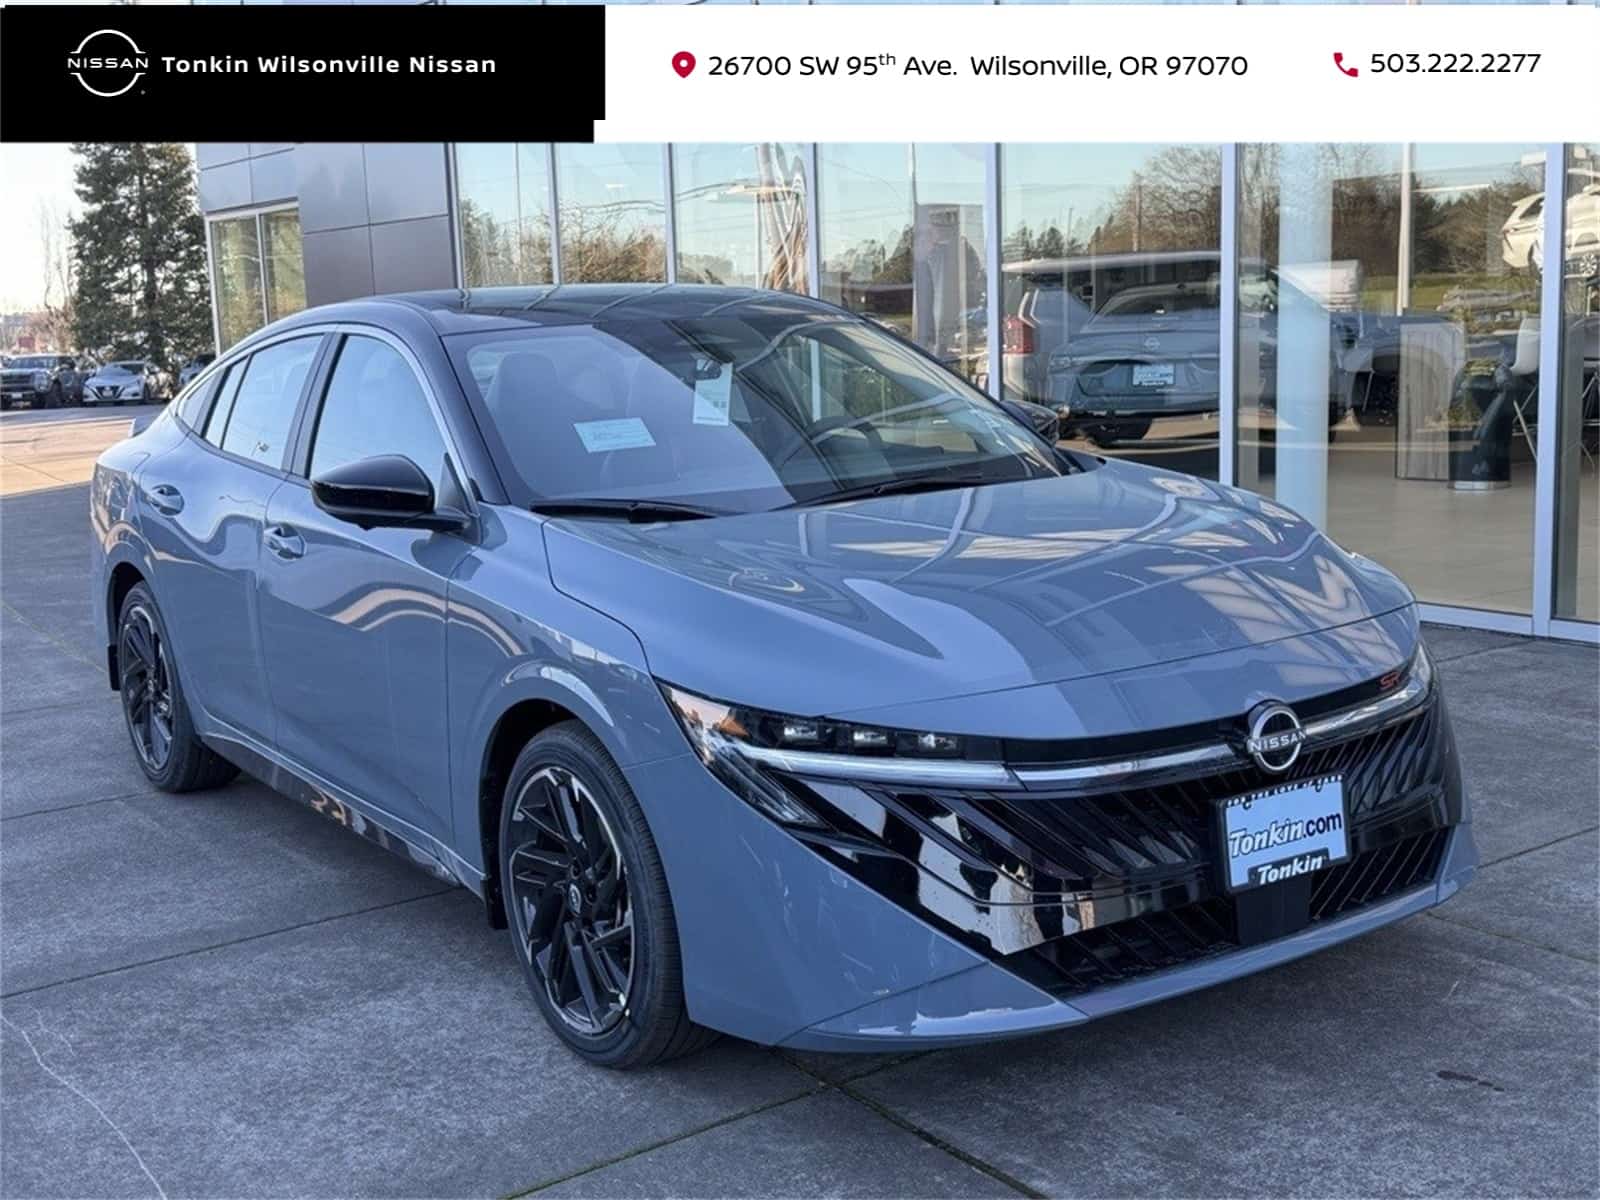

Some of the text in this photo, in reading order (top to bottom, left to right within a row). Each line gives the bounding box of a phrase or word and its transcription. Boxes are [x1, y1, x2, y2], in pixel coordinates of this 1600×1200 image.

[1249, 730, 1306, 751] NISSAN
[1230, 813, 1342, 858] Tonkin.com
[1258, 855, 1323, 886] Tonkin
